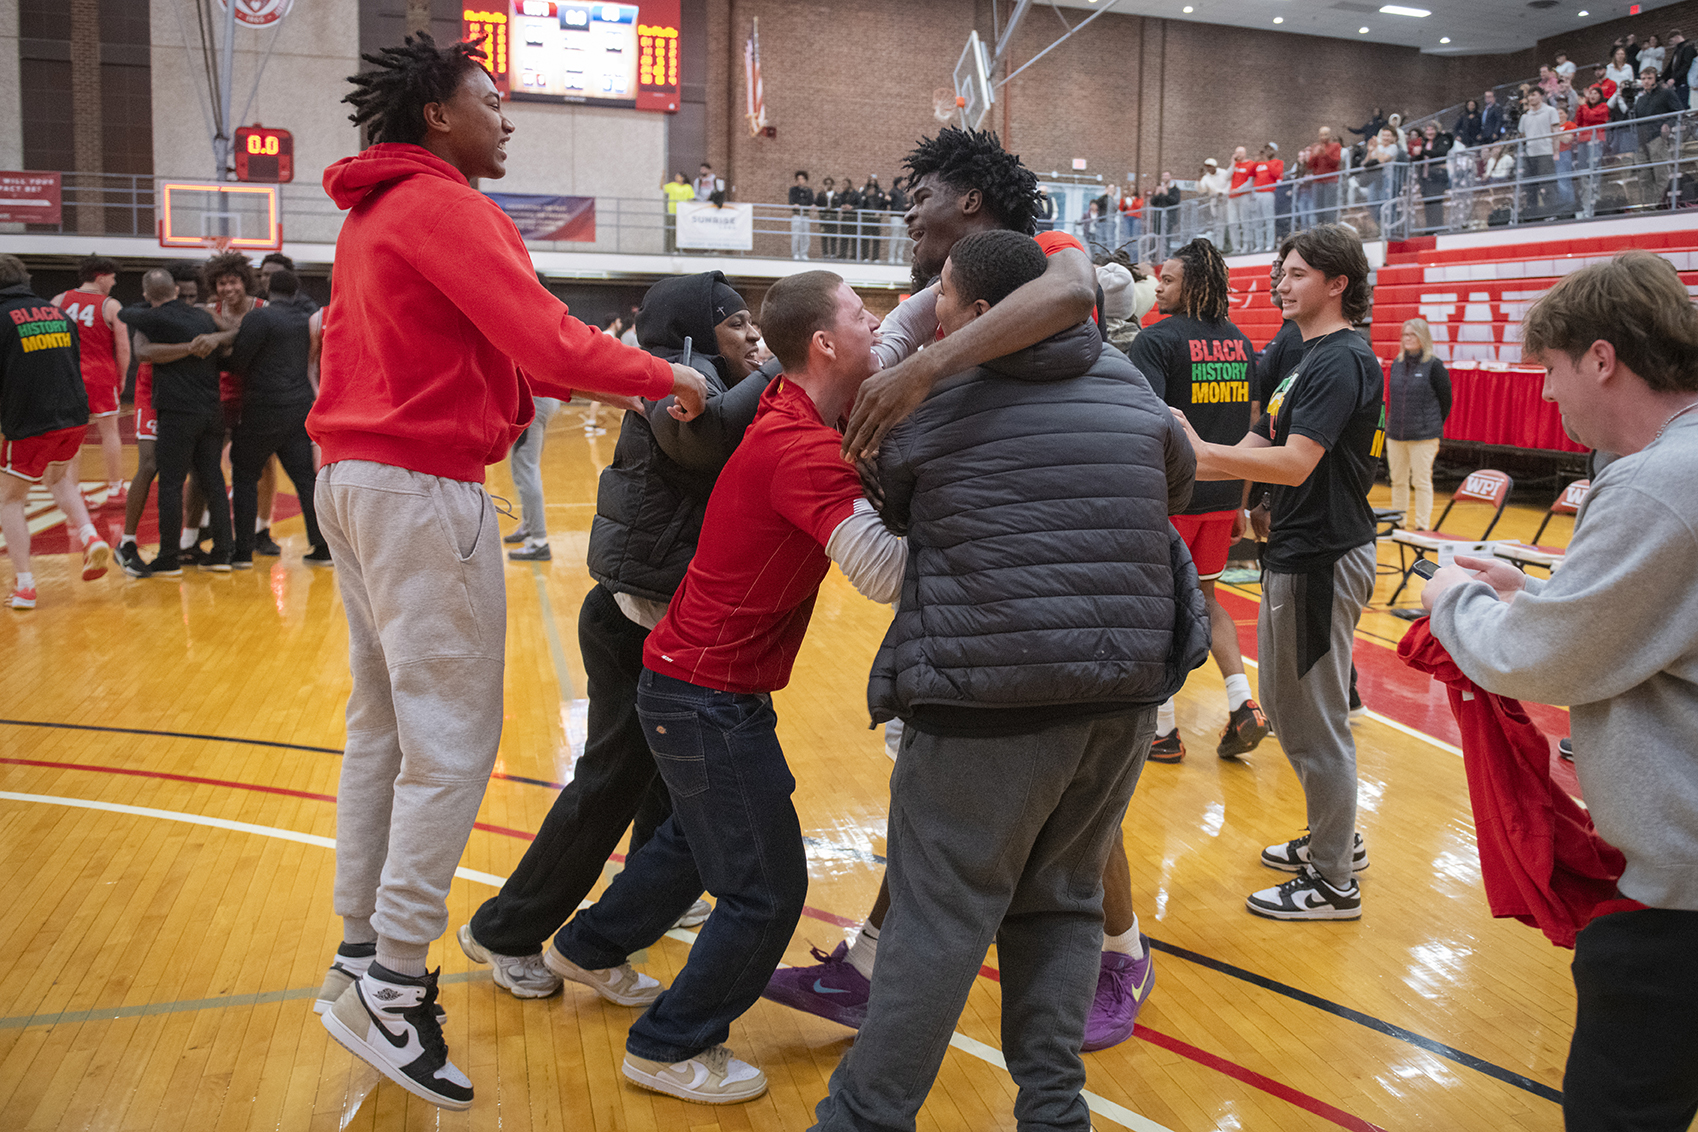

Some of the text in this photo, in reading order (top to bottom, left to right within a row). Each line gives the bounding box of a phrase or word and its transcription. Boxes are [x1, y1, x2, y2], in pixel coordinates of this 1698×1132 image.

[246, 134, 280, 156] 0.0
[691, 216, 736, 224] SUNRISE
[9, 306, 64, 325] BLACK
[65, 303, 95, 327] 44
[17, 320, 67, 337] HISTORY
[21, 332, 71, 353] MONTH
[1188, 339, 1248, 361] BLACK
[1191, 362, 1248, 381] HISTORY
[1191, 381, 1249, 404] MONTH
[1466, 476, 1502, 496] WPI
